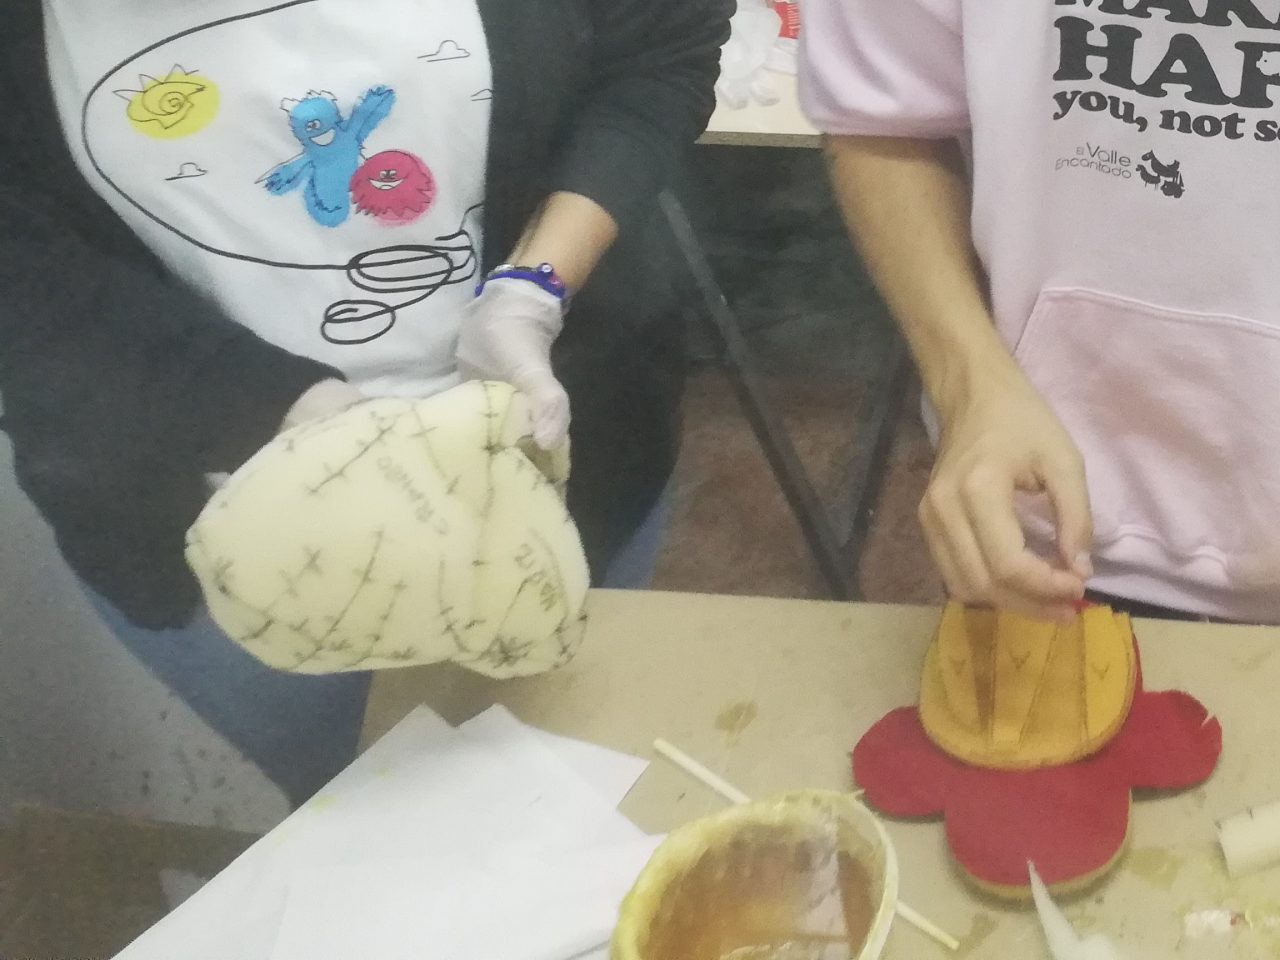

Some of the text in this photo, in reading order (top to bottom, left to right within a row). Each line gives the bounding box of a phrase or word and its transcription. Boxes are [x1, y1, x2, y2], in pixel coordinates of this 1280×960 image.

[1053, 91, 1147, 133] you,
[1159, 110, 1245, 140] not
[1087, 142, 1131, 167] Valle
[1055, 157, 1132, 179] Encantado
